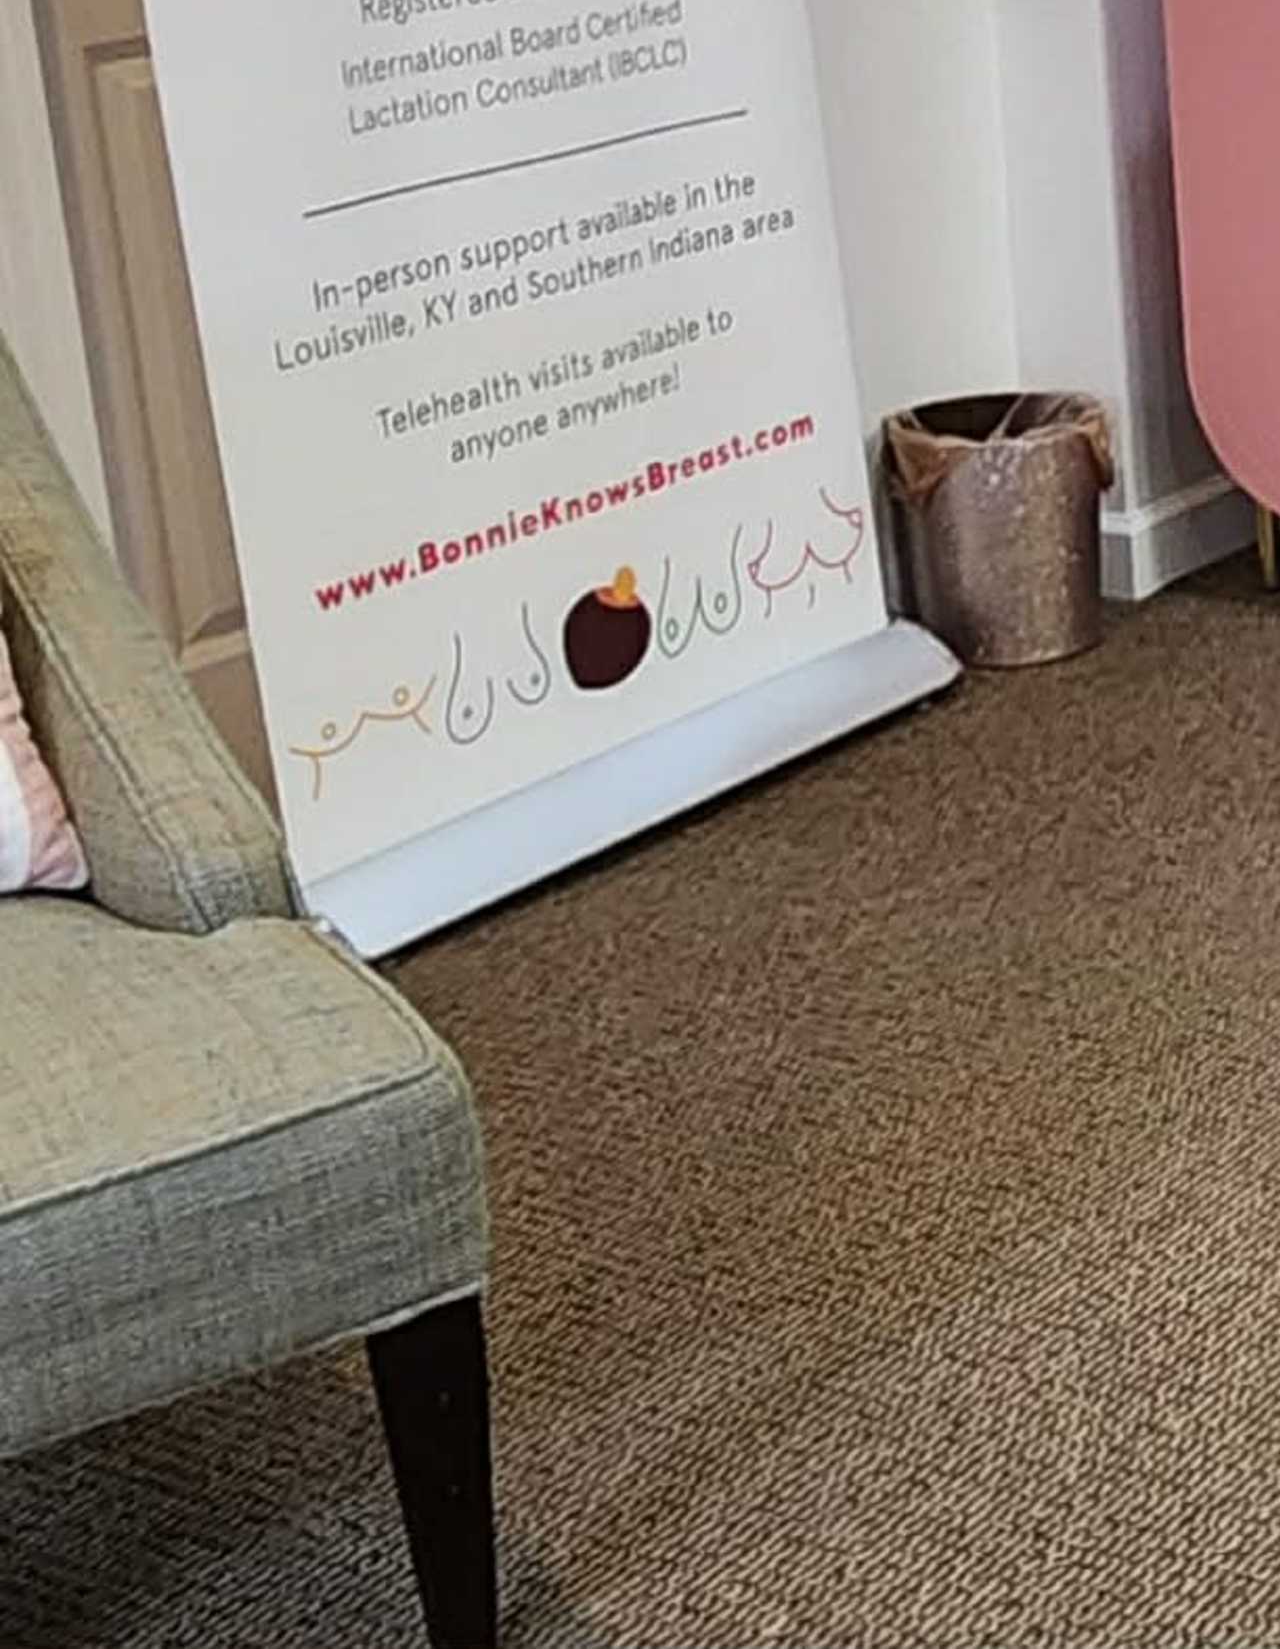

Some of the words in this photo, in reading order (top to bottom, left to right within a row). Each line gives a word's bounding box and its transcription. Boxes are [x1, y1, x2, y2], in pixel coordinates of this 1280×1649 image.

[342, 32, 503, 90] International
[511, 14, 581, 58] Board
[586, 0, 683, 40] Certified
[349, 87, 468, 136] Lactation
[476, 58, 603, 107] Consultant
[608, 38, 687, 81] (IBCLC)
[275, 312, 415, 372] Louisville,
[422, 293, 456, 323] KY
[468, 278, 518, 317] and
[527, 251, 644, 301] Southern
[649, 223, 734, 264] Indiana
[742, 209, 795, 241] area
[313, 252, 451, 313] In-person
[459, 222, 571, 274] support
[577, 193, 676, 238] available
[684, 182, 707, 211] in
[715, 173, 756, 204] the
[376, 373, 520, 439] Telehealth
[530, 350, 594, 393] visits
[602, 319, 700, 372] available
[708, 309, 733, 339] to
[451, 415, 548, 465] anyone
[557, 365, 681, 431] anywhere!
[315, 415, 815, 612] www.BonnieKnowsBreast.com
